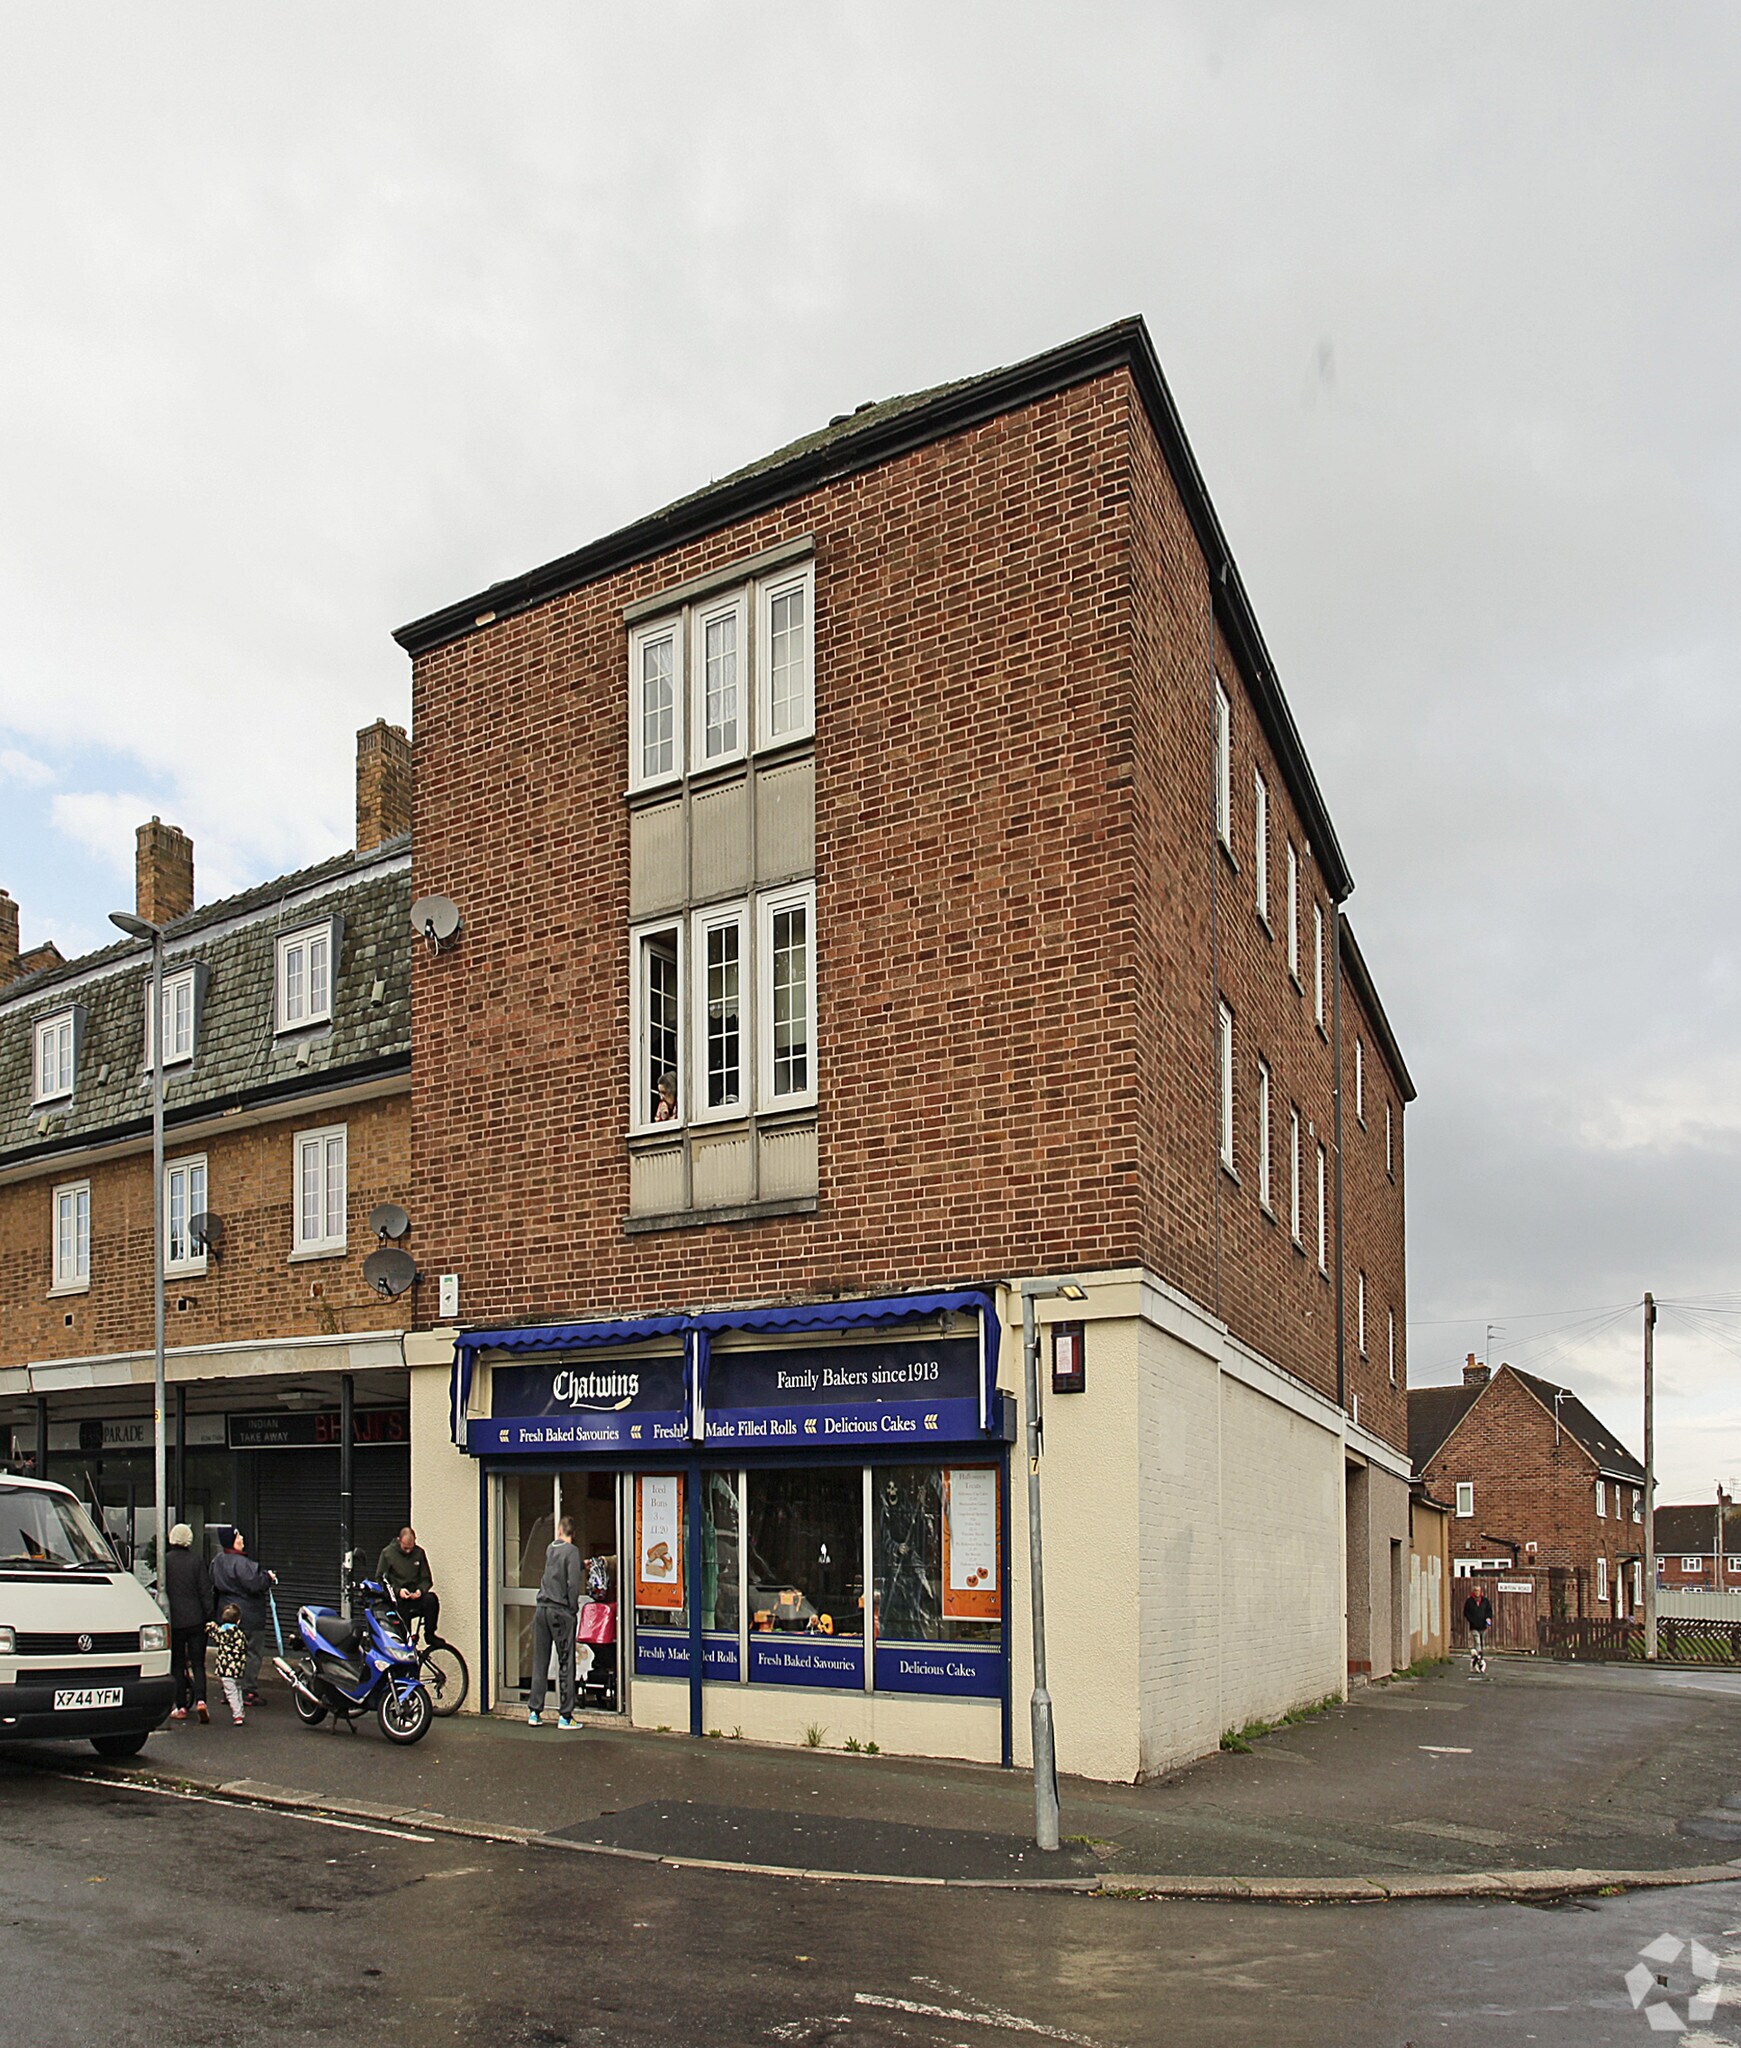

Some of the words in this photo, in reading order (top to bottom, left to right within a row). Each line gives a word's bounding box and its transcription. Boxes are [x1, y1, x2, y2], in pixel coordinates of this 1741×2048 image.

[777, 1369, 819, 1391] Family
[822, 1367, 868, 1387] Bakers
[553, 1370, 640, 1408] Chatwins
[248, 1419, 279, 1429] INDIAN
[519, 1428, 543, 1442] Fresh
[546, 1427, 574, 1442] Baked
[576, 1426, 619, 1441] Savouries
[705, 1421, 735, 1437] Made
[737, 1420, 767, 1436] Filled
[770, 1419, 797, 1435] Rolls
[824, 1417, 878, 1434] Delicious
[881, 1415, 916, 1432] Cakes
[104, 1425, 144, 1442] PARADE
[240, 1433, 261, 1443] TAKE
[264, 1432, 288, 1442] AWAY
[1031, 1458, 1038, 1472] 7
[638, 1646, 666, 1661] Freshly
[668, 1648, 690, 1661] Made
[717, 1650, 738, 1664] Rolls
[758, 1653, 782, 1666] Fresh
[784, 1654, 811, 1668] Baked
[813, 1656, 855, 1671] Savouries
[900, 1661, 944, 1675] Delicious
[946, 1663, 976, 1677] Cakes
[56, 1691, 93, 1706] X744
[97, 1690, 121, 1704] YFM
